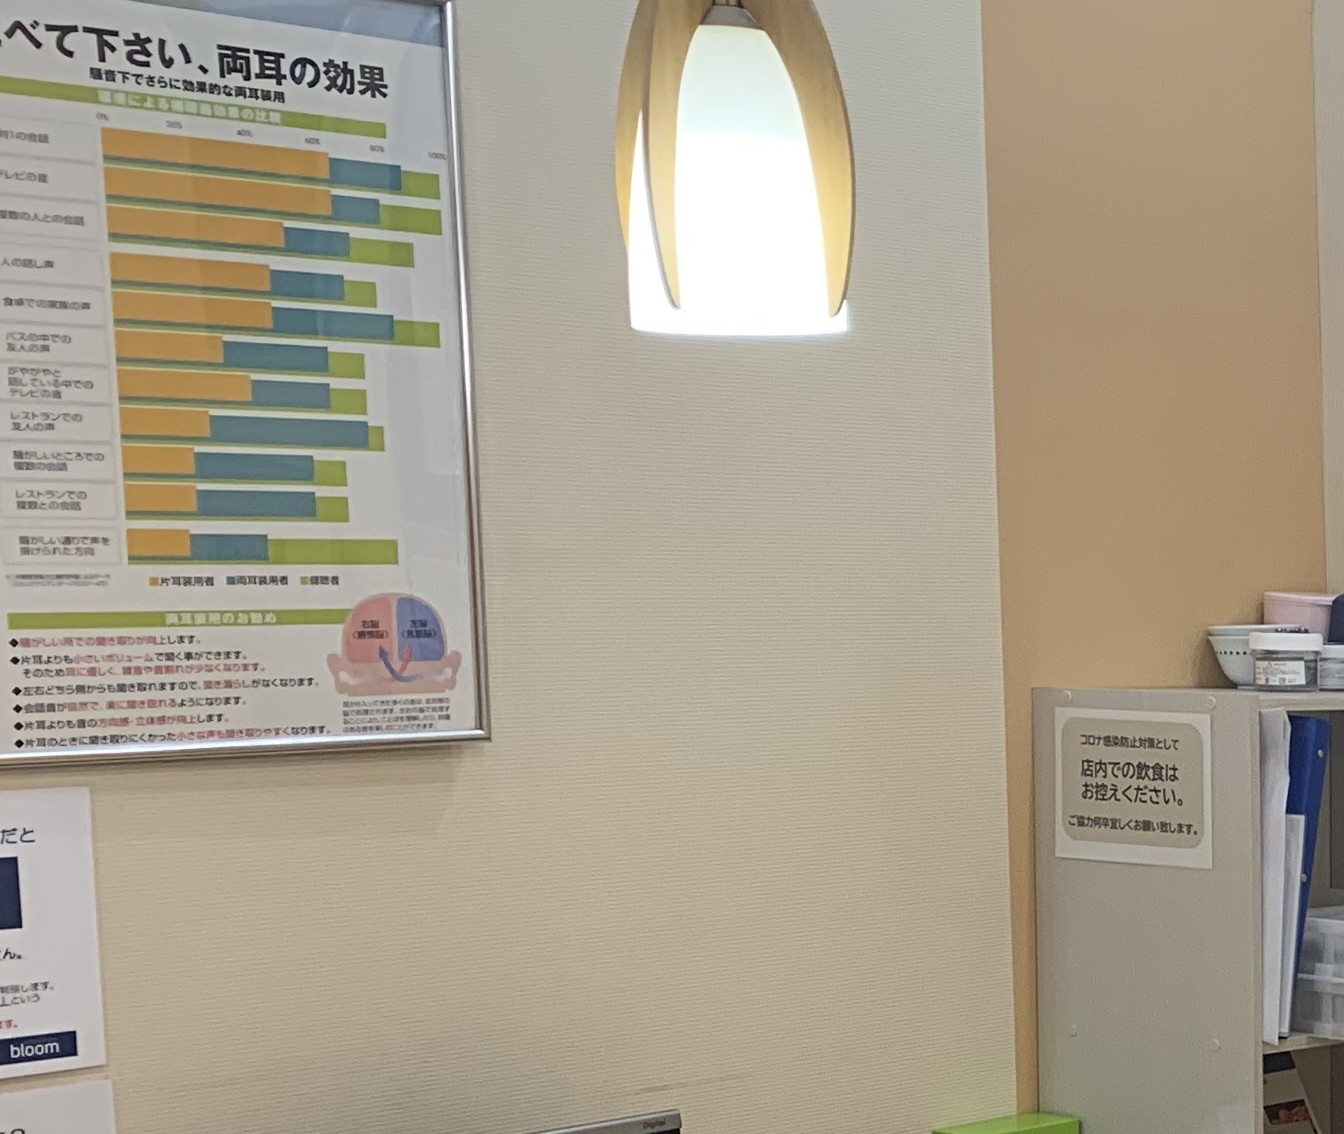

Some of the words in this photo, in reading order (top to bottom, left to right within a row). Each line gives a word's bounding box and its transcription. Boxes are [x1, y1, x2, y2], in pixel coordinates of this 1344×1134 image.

[0, 19, 389, 99] べて下さい、両耳の効果
[1080, 759, 1179, 782] 店内での飲食は
[1081, 782, 1183, 806] お控えください。
[10, 1041, 60, 1059] bloom
